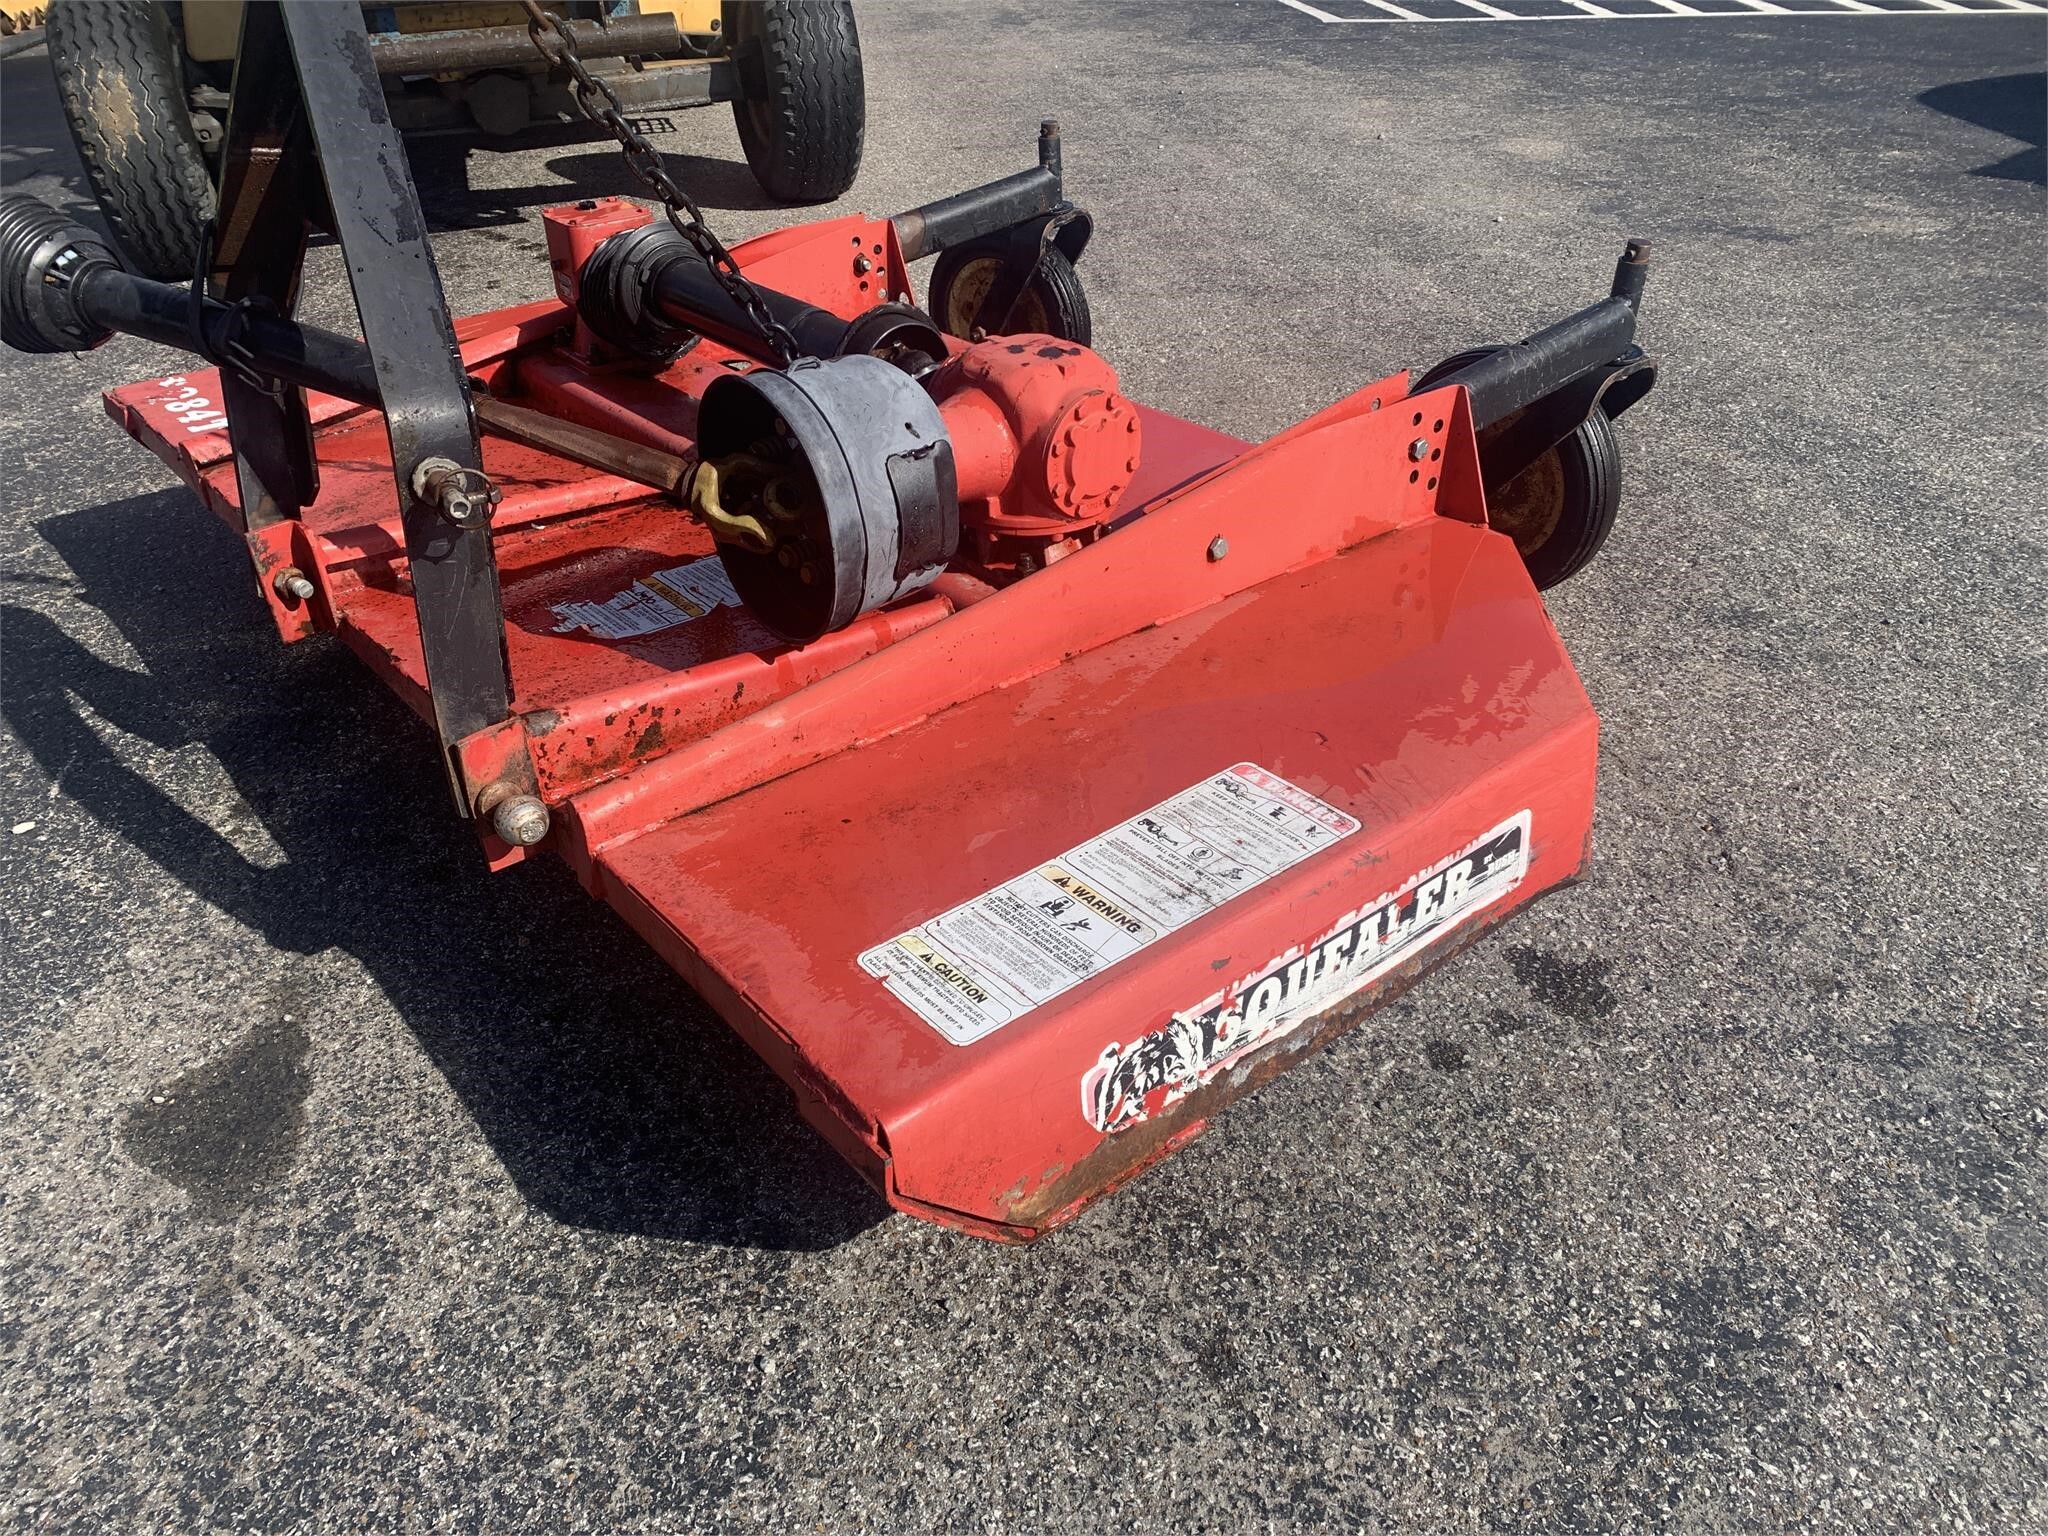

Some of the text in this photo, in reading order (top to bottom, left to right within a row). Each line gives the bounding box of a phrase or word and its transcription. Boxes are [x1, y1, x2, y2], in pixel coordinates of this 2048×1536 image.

[1225, 800, 1244, 810] AWAY
[1127, 829, 1154, 845] PREVENT
[1153, 844, 1168, 853] FALL
[1167, 853, 1180, 861] OFF
[1178, 860, 1195, 870] INTO
[982, 902, 1016, 926] BYSTANDERS
[1013, 925, 1032, 937] FROM
[1028, 936, 1054, 954] THROWN
[993, 895, 1018, 912] OBJECTS
[1015, 911, 1042, 929] SEVERAL
[1039, 928, 1071, 949] HUNDREDS
[1005, 896, 1094, 958] ROTARY CUTTERS CAN DISCHARGE
[1069, 885, 1143, 933] WARNING
[993, 903, 1012, 915] AVOID
[1009, 914, 1034, 931] SERIOUS
[1031, 930, 1054, 945] INJURY
[1051, 944, 1063, 952] OR
[1059, 950, 1081, 965] DEATH
[932, 961, 988, 1004] CAUTION
[1211, 859, 1474, 1058] SQUEALER
[904, 981, 926, 998] SHIELDS
[922, 996, 939, 1008] MUST
[943, 1013, 958, 1025] KEPT
[931, 986, 954, 1005] TRACTOR
